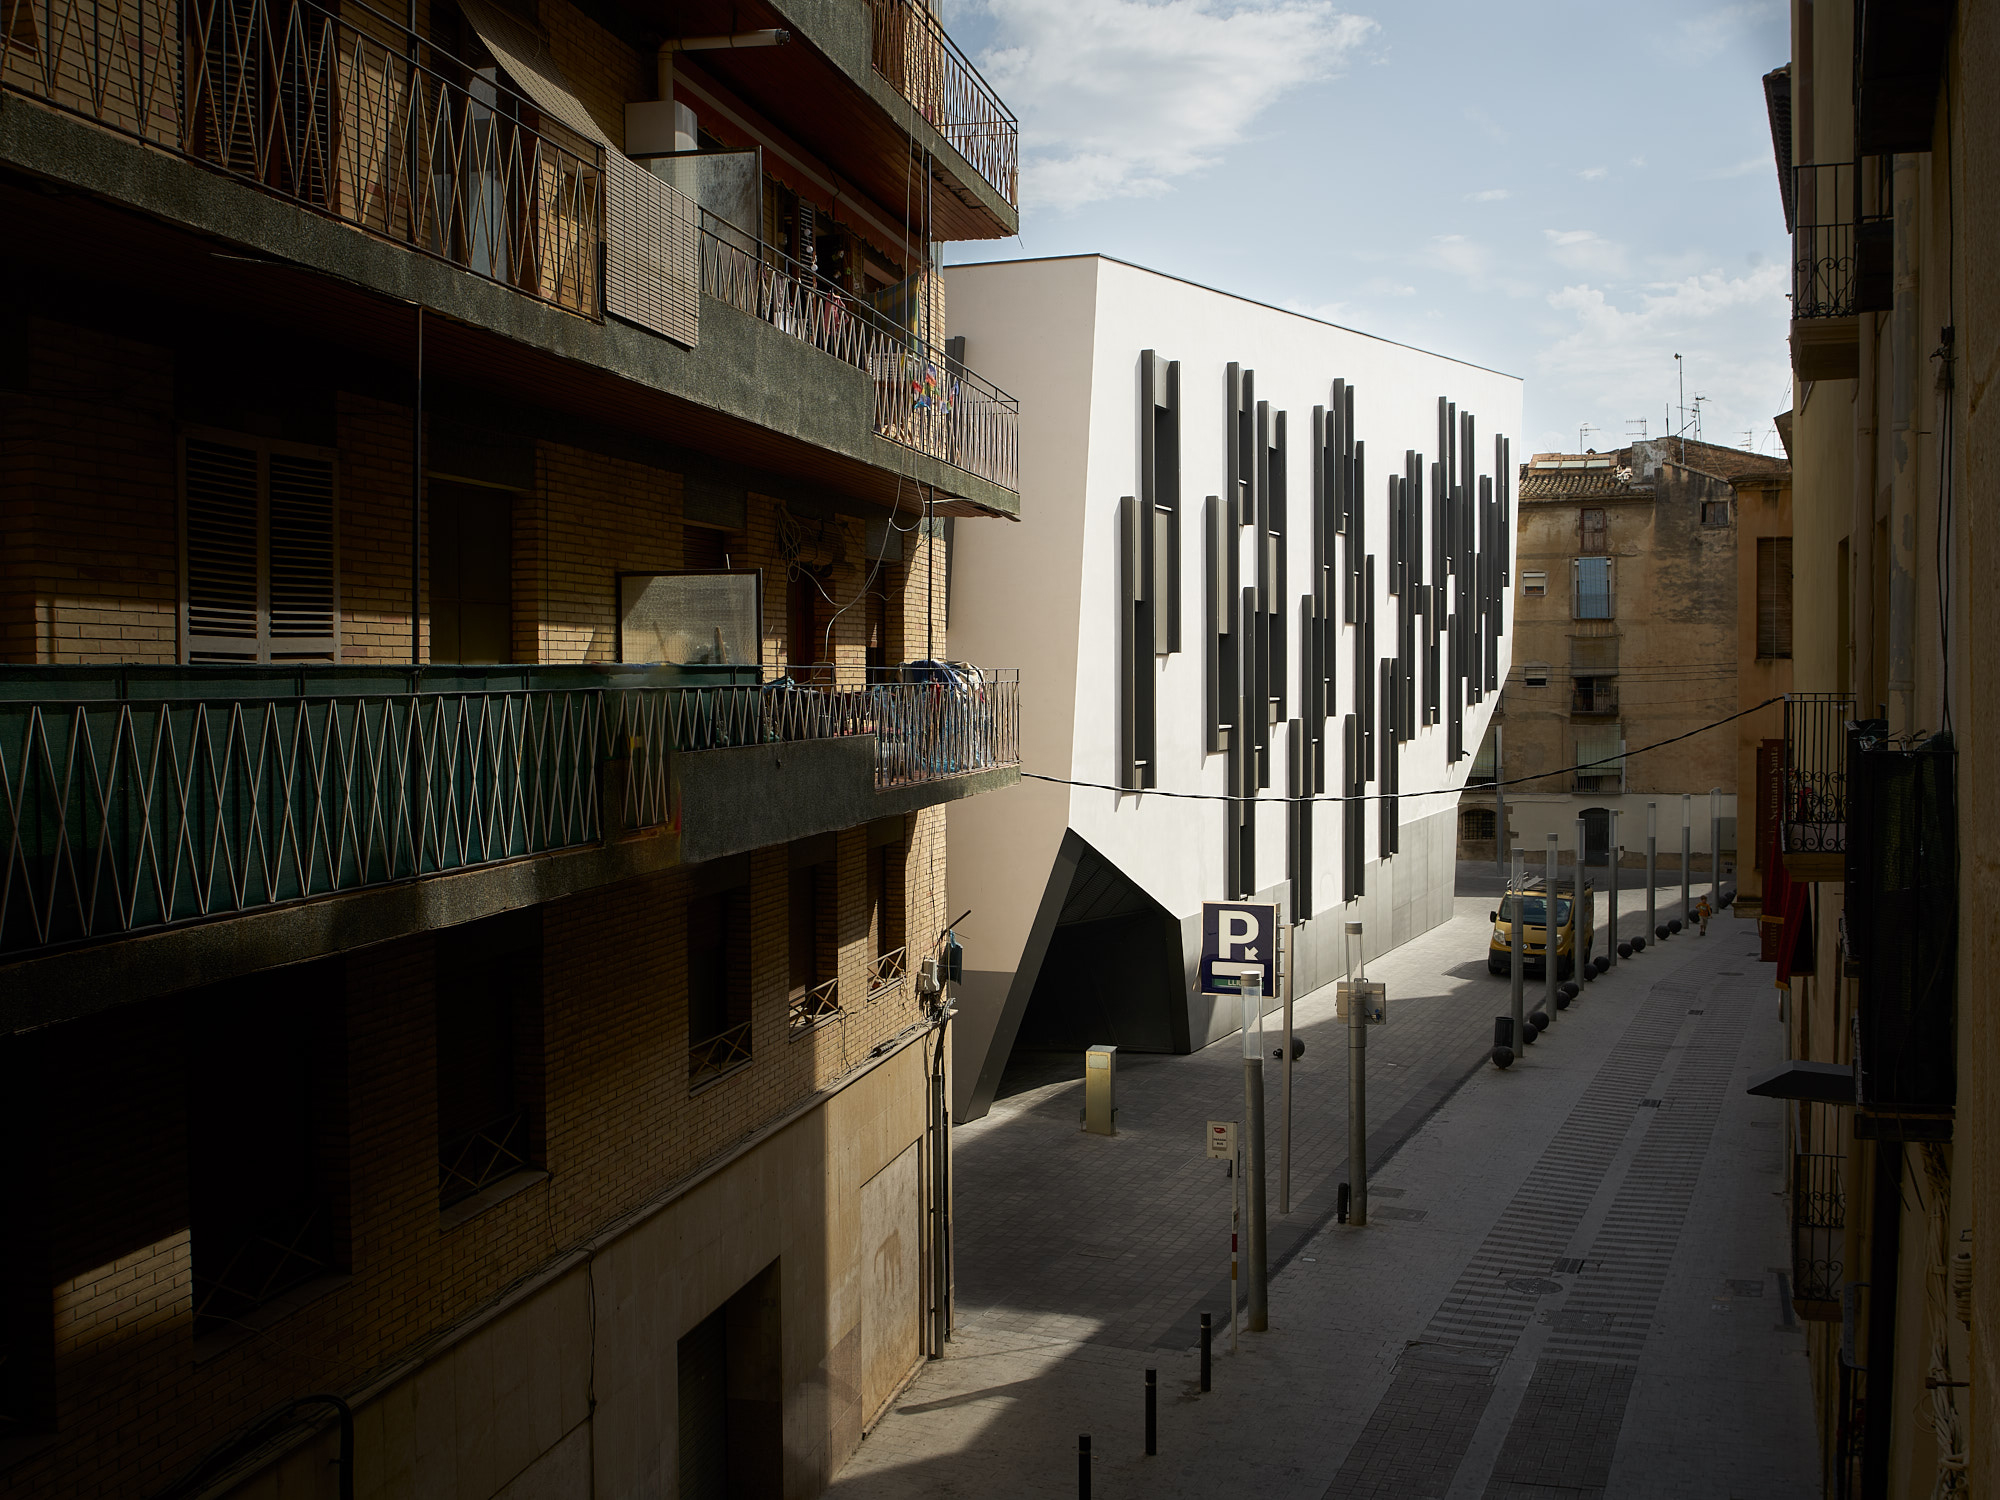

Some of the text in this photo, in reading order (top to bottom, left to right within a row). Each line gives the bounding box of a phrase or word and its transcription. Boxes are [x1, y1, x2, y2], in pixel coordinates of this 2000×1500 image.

[1768, 746, 1779, 776] Santa
[1768, 777, 1778, 821] Setmana
[1218, 909, 1259, 959] P
